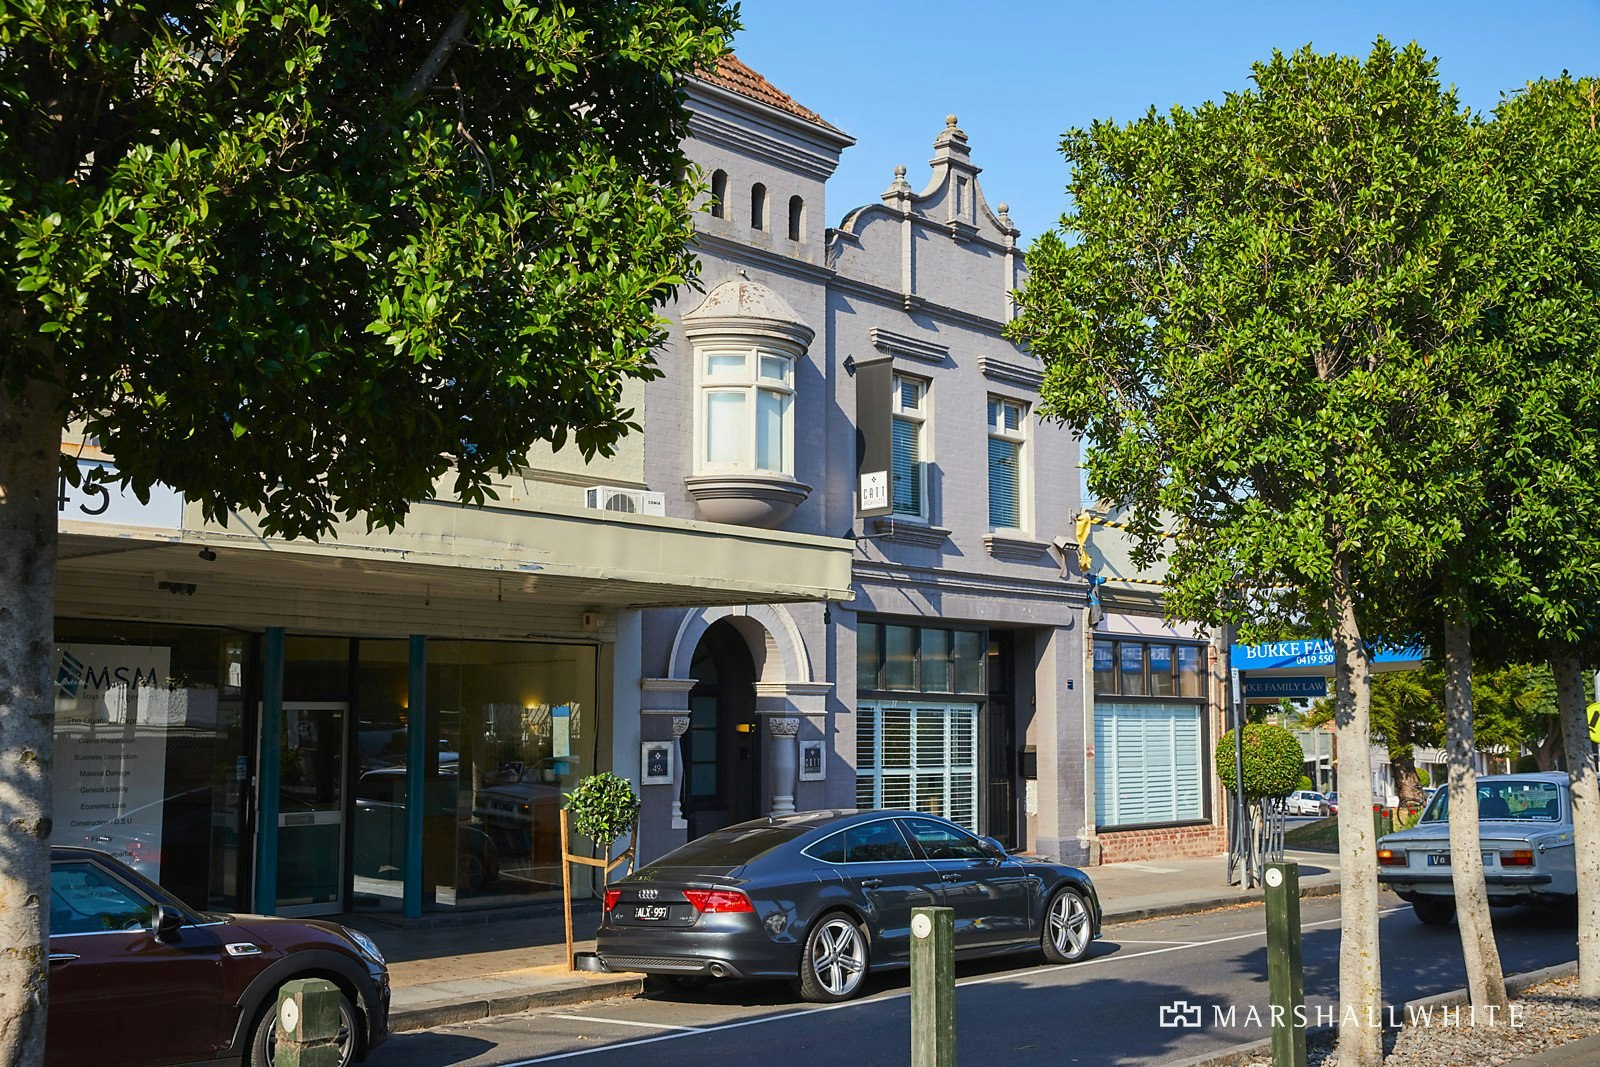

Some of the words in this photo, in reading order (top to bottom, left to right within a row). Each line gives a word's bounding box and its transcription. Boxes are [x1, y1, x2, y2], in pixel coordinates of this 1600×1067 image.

[863, 486, 885, 500] CATT
[1246, 642, 1300, 659] BURKE
[1304, 640, 1336, 655] FAM
[1296, 655, 1317, 665] 0419
[1318, 654, 1334, 664] 550
[83, 666, 159, 691] MSM
[1245, 683, 1263, 692] RKE
[1265, 682, 1300, 692] FAMILY
[1302, 682, 1324, 691] LAW
[80, 769, 104, 777] Material
[80, 786, 105, 794] General
